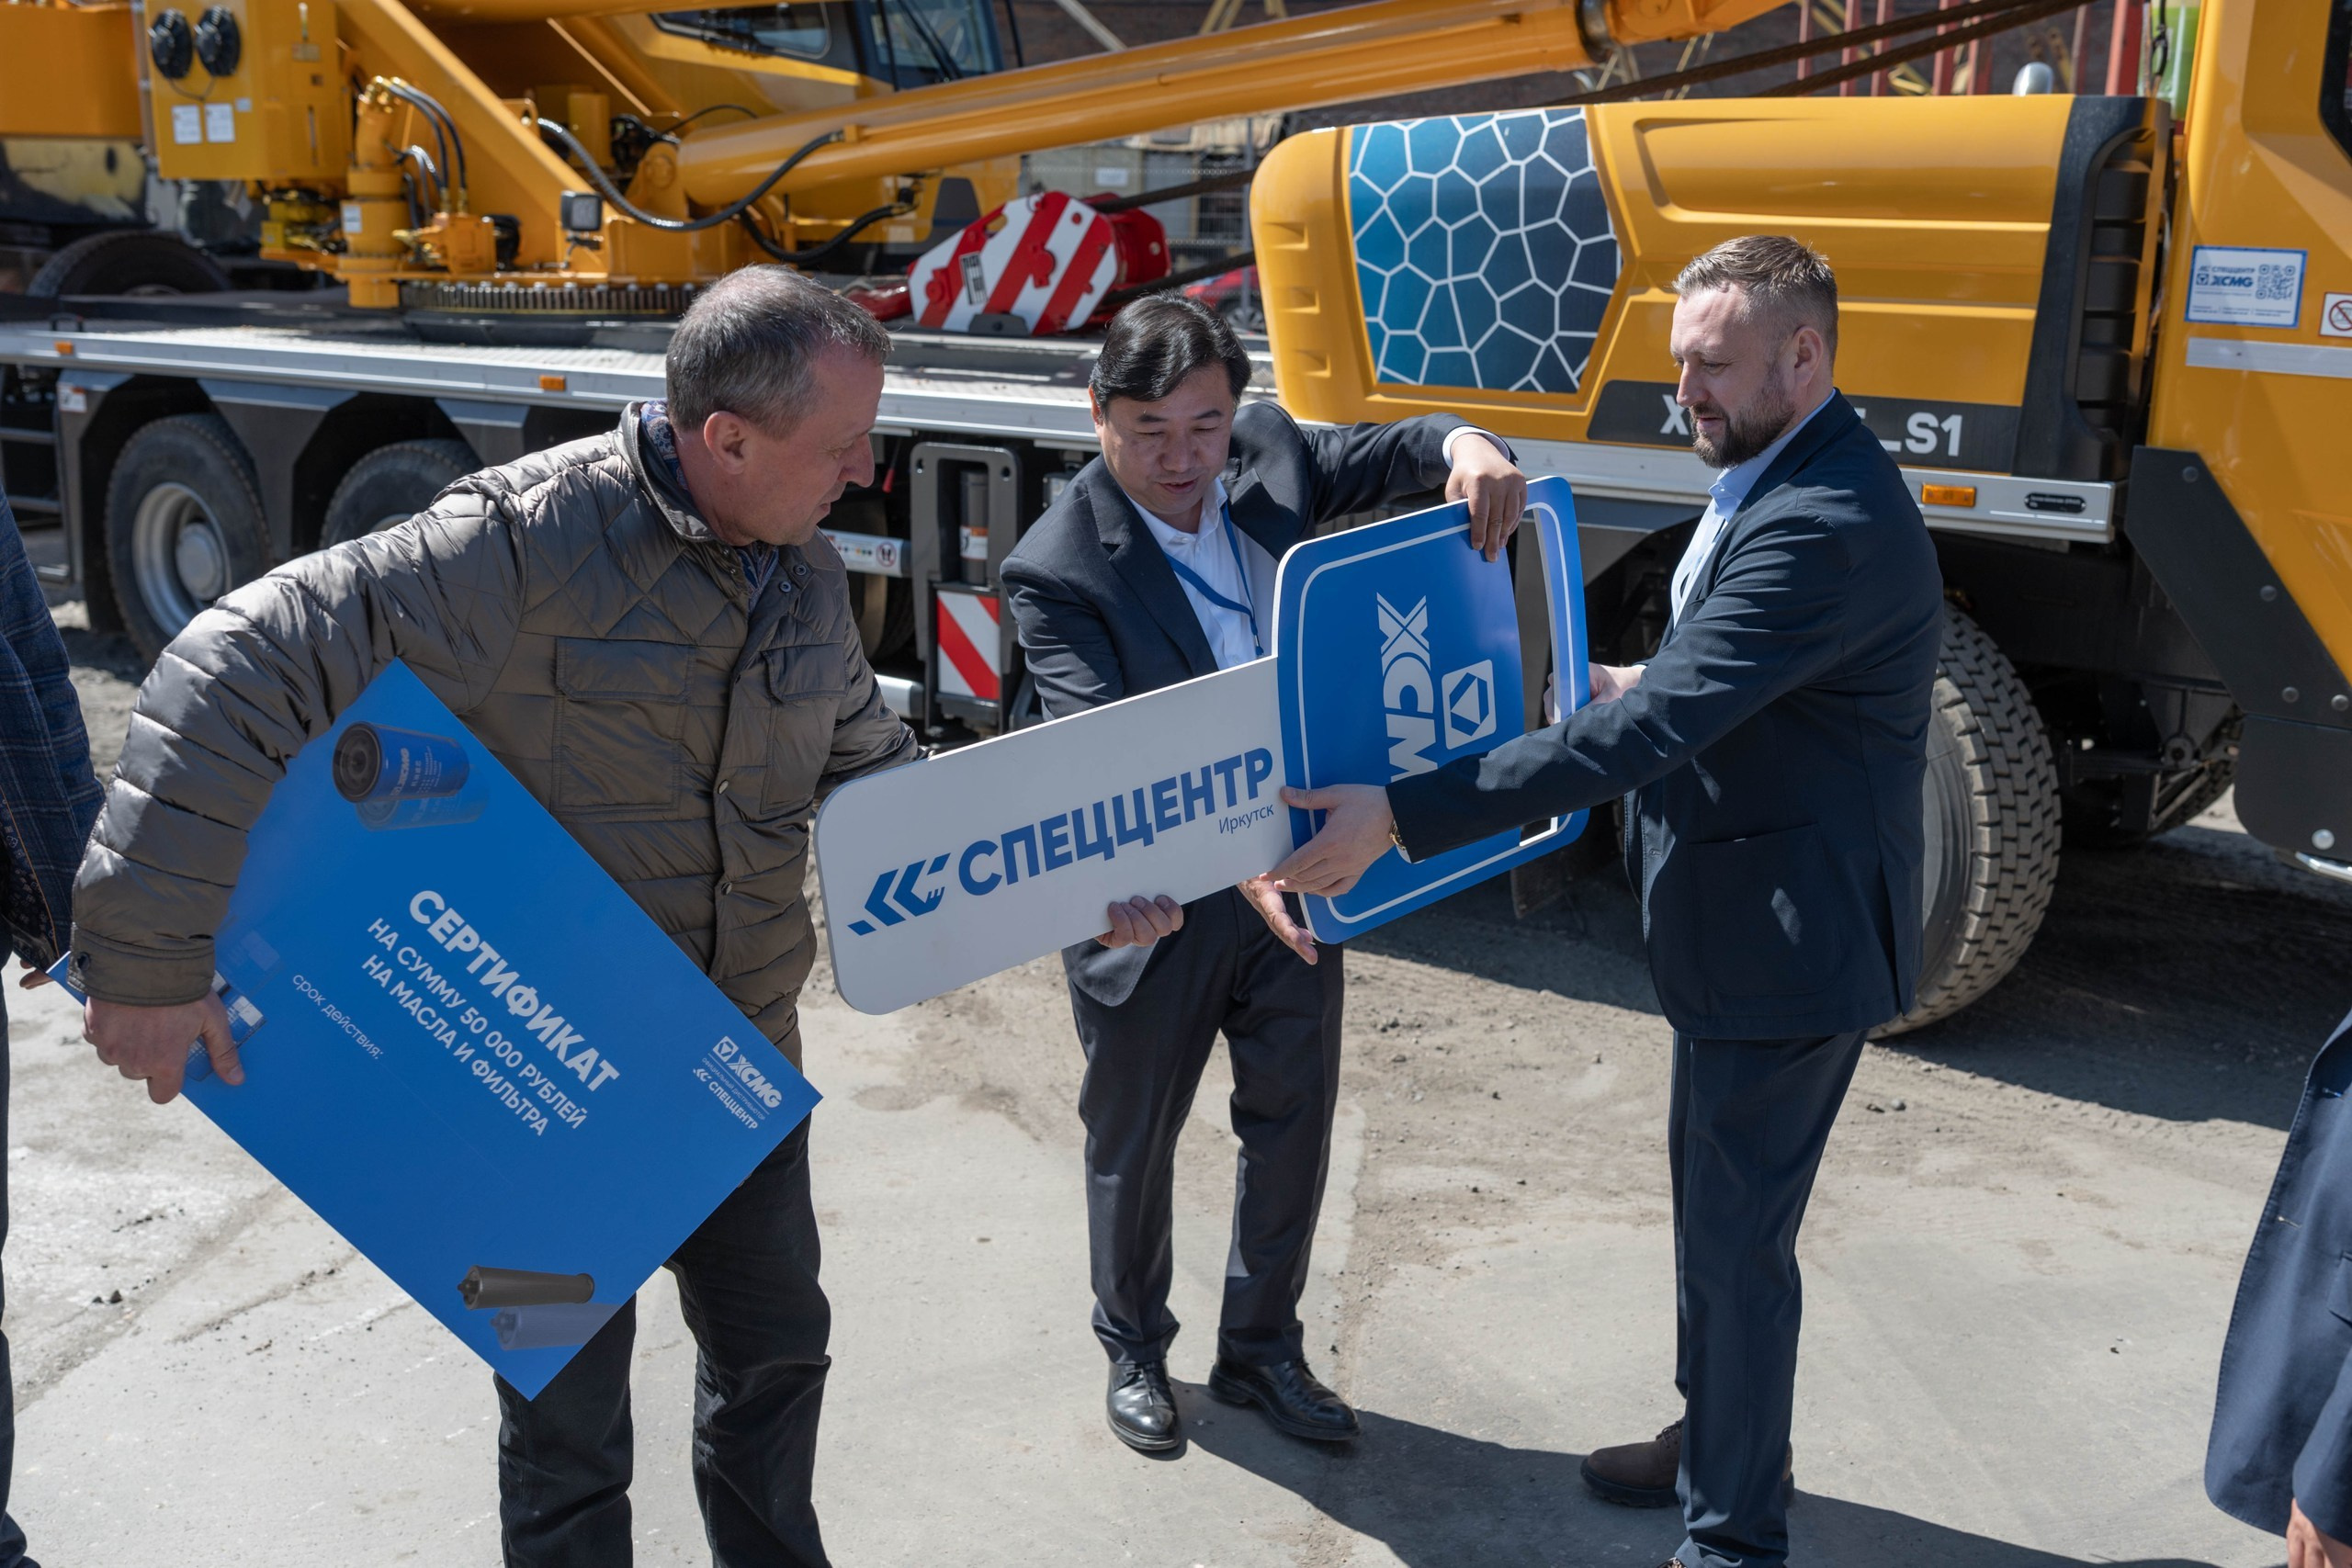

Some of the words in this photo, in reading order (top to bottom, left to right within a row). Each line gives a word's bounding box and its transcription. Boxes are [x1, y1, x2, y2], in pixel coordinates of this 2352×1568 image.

[2211, 276, 2254, 288] XCMG
[1376, 592, 1439, 784] XCM
[958, 747, 1273, 897] СПЕЦЦЕНТР
[1218, 804, 1274, 834] Иркутск
[292, 974, 326, 1007] срок
[322, 1003, 384, 1060] действия:
[361, 954, 394, 988] НА
[390, 981, 460, 1049] МАСЛА
[453, 1042, 476, 1064] И
[471, 1059, 548, 1136] ФИЛЬТРА
[368, 918, 400, 951] НА
[397, 946, 467, 1010] СУММУ
[459, 1007, 488, 1034] 50
[484, 1031, 523, 1068] 000
[518, 1063, 588, 1129] РУБЛЕЙ
[409, 889, 620, 1092] СЕРТИФИКАТ
[708, 1081, 759, 1129] СПЕЦЦЕНТР
[727, 1054, 782, 1108] XCMG
